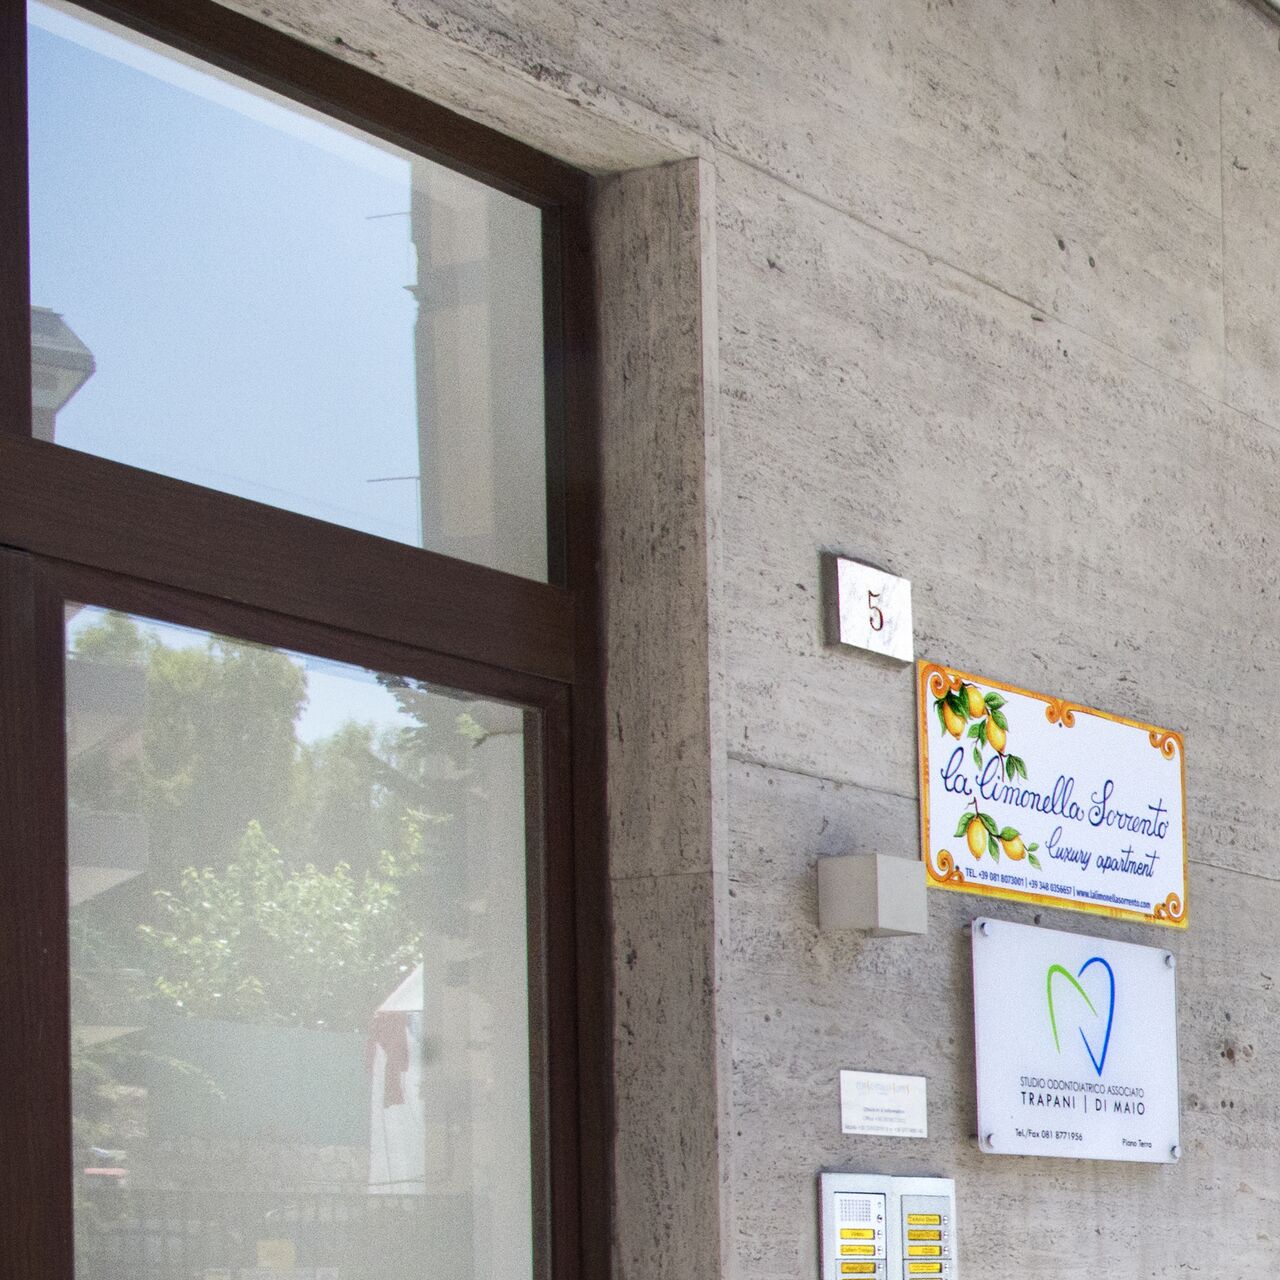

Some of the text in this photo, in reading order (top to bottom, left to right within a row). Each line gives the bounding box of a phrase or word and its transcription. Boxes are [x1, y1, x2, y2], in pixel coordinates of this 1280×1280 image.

[868, 590, 884, 631] 5
[1088, 779, 1169, 839] Sorrento
[1096, 844, 1160, 877] apartment
[1020, 1076, 1144, 1098] STUDIO ODONTOIATRICO ASSOCIATO
[1021, 1091, 1145, 1115] TRAPANI DI MAIO
[1041, 1129, 1053, 1139] 081
[1055, 1130, 1083, 1141] 8771956
